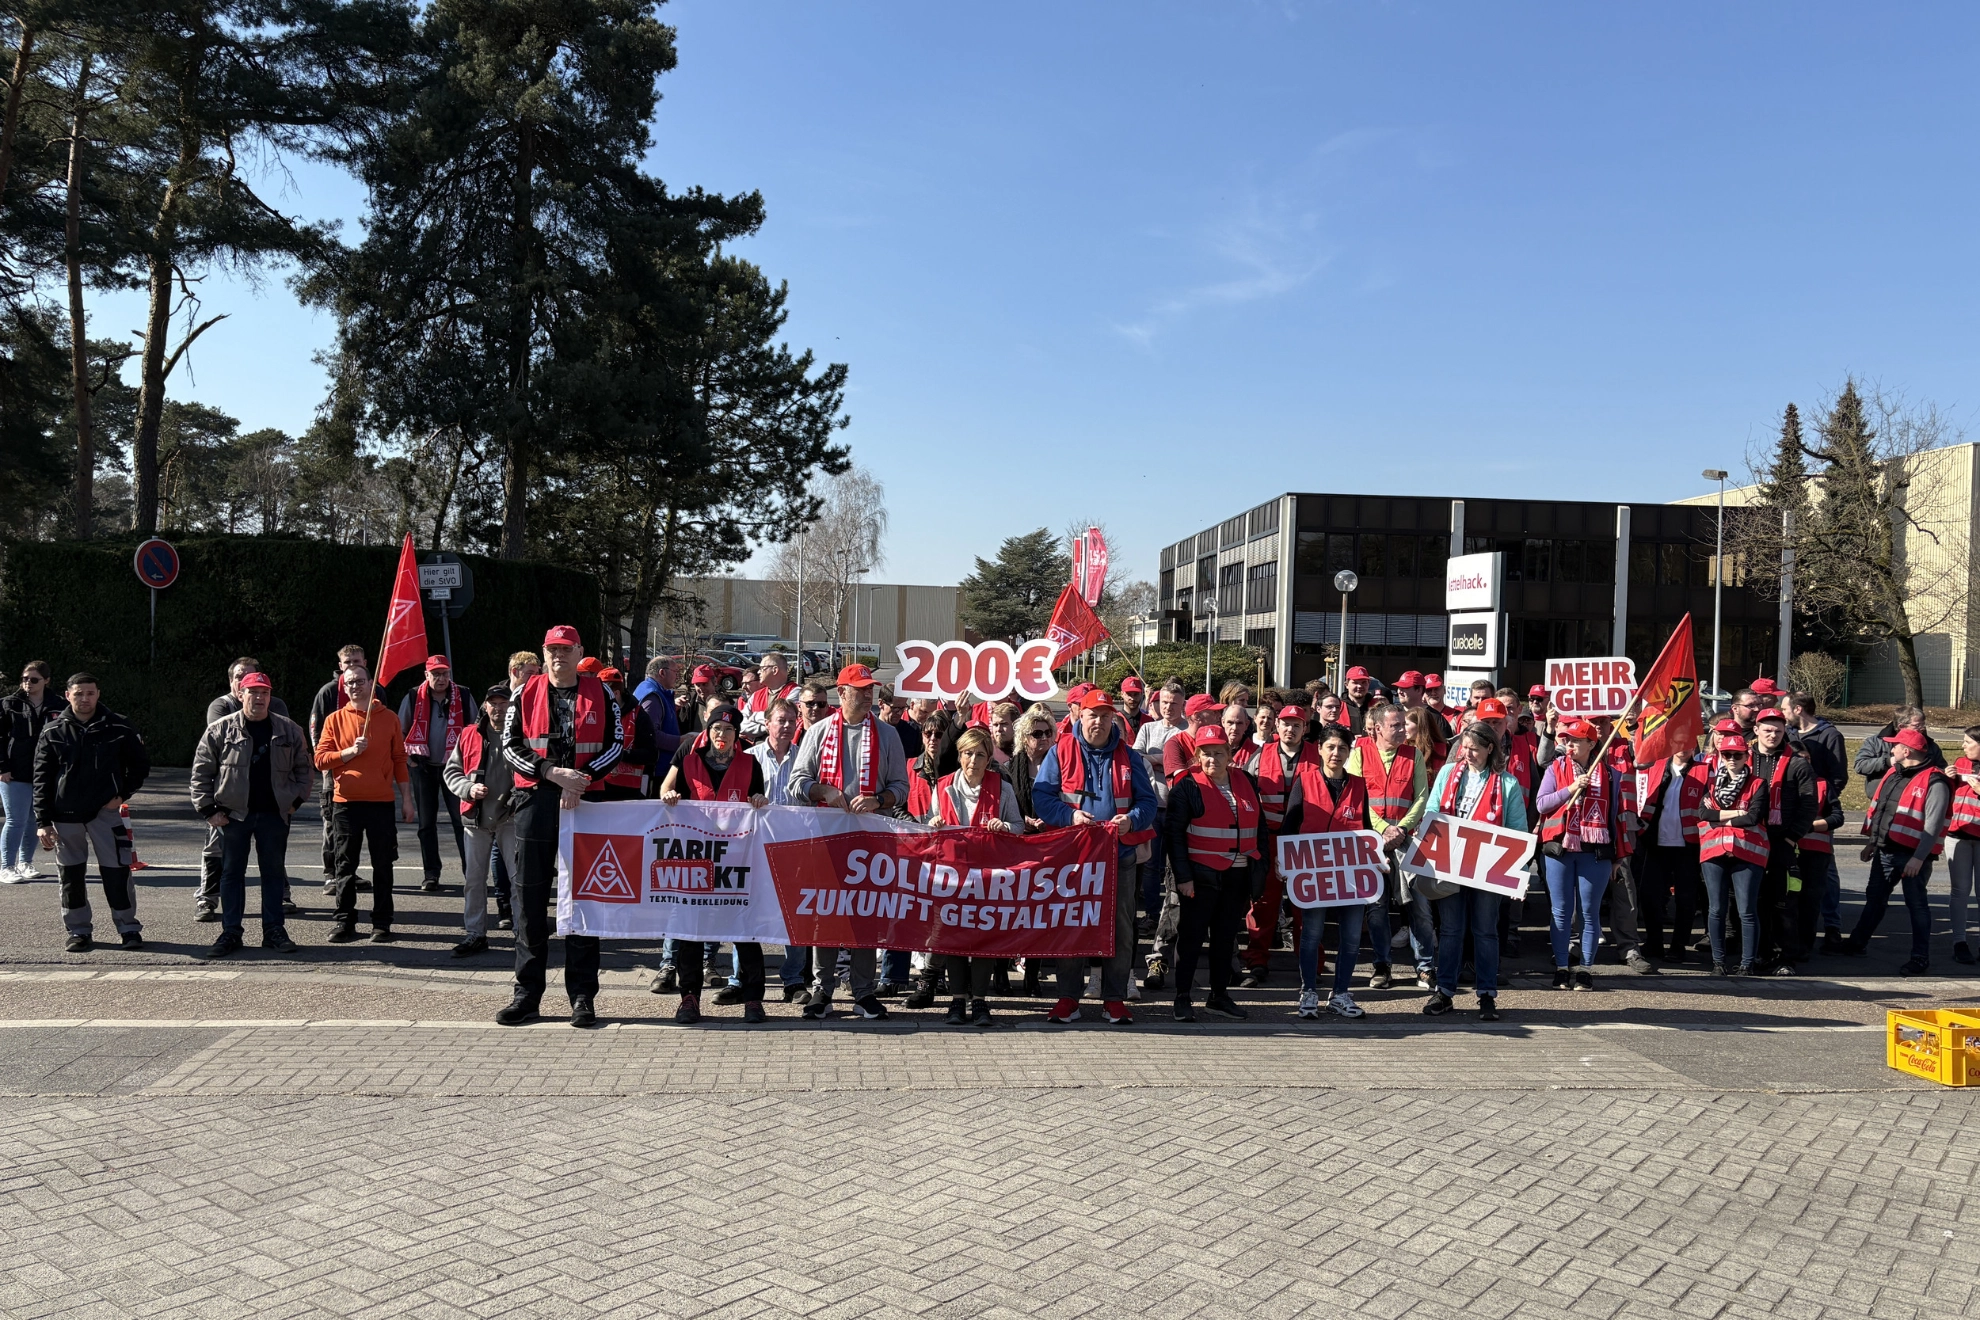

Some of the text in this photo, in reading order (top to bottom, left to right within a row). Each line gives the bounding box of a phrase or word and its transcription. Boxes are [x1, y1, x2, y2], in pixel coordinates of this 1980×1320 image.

[443, 568, 455, 577] gilt
[901, 645, 1052, 695] 200€
[1550, 662, 1632, 686] MEHR
[1446, 686, 1472, 703] SETE
[1555, 687, 1627, 712] GELD
[611, 702, 624, 740] adidas
[652, 838, 729, 863] TARIF
[1283, 835, 1381, 871] MEHR
[1410, 820, 1528, 890] ATZ
[844, 849, 1107, 900] SOLIDARISCH
[1293, 868, 1378, 903] GELD
[649, 895, 680, 904] TEXTIL
[690, 898, 749, 906] BEKLEIDUNG
[795, 888, 1102, 931] ZUKUNFT GESTALTEN
